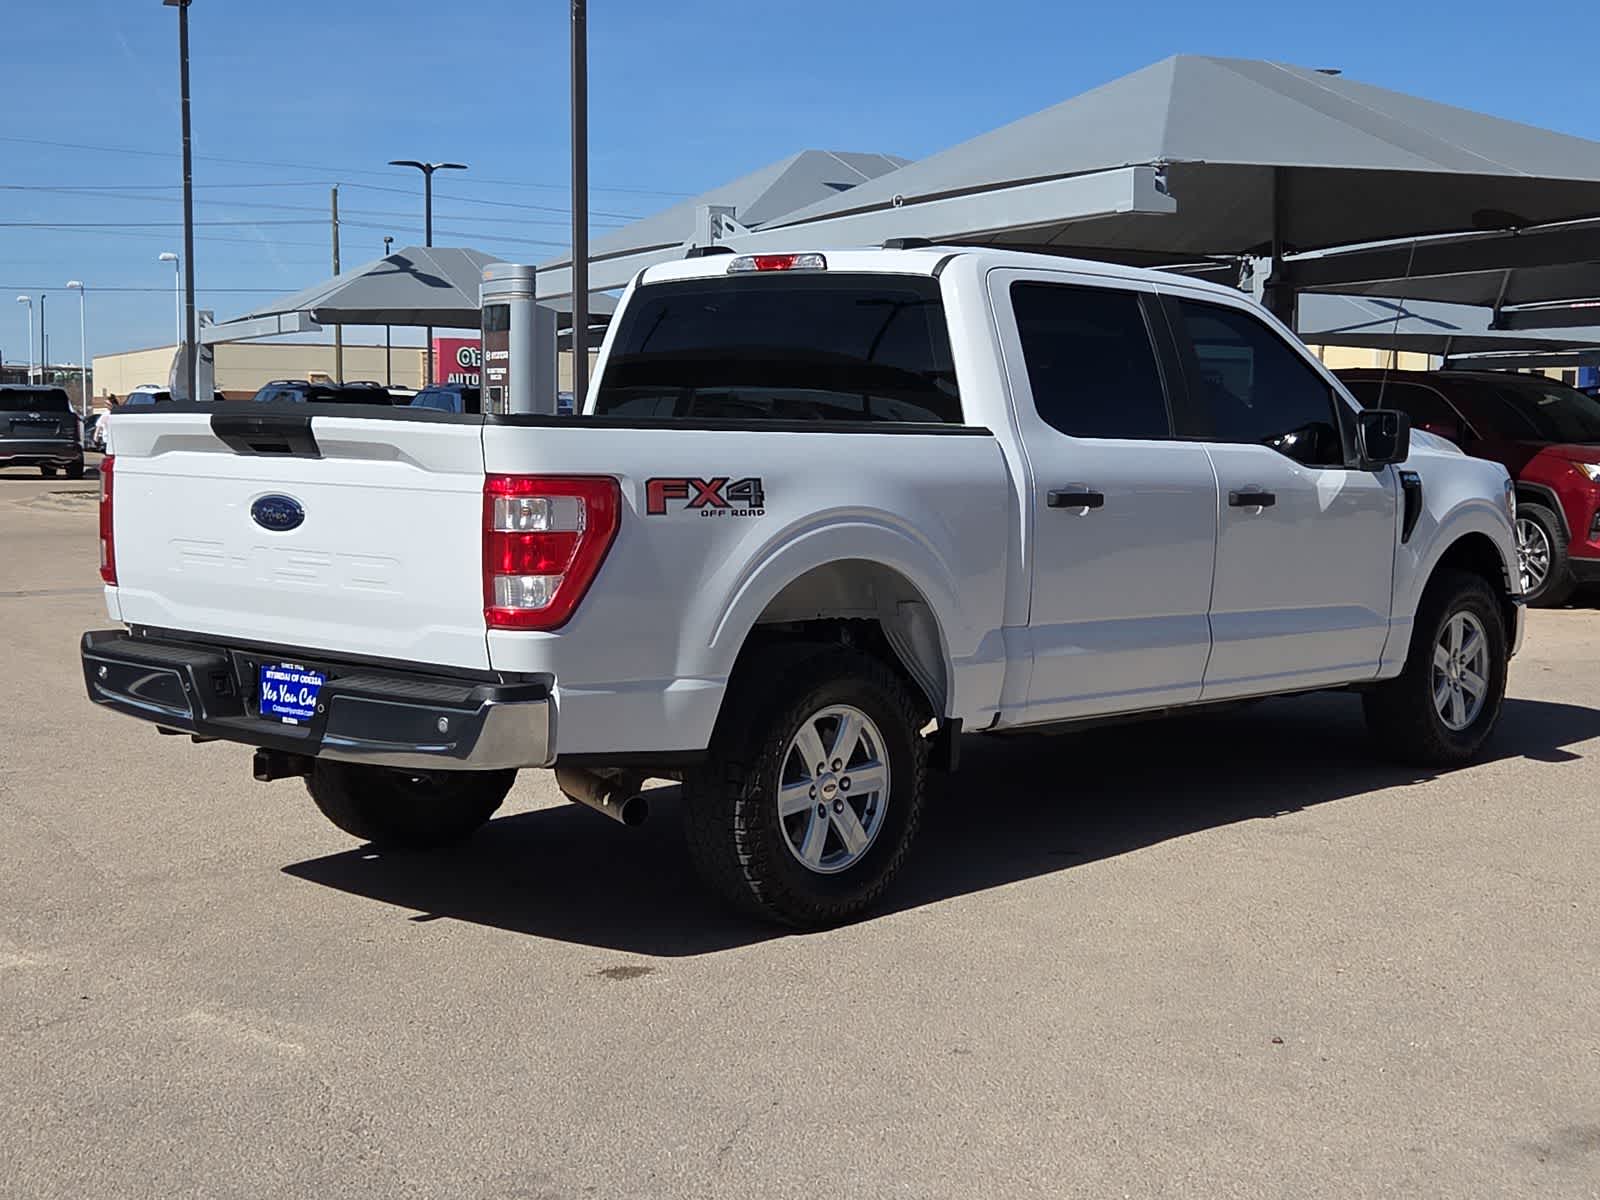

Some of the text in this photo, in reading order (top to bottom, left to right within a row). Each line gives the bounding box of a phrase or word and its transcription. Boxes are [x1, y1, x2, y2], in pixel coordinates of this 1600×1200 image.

[447, 372, 480, 385] AUTO
[645, 476, 765, 517] FX4
[700, 509, 766, 518] OFF ROAD
[291, 673, 300, 683] OF
[262, 681, 278, 702] Yes
[279, 684, 298, 704] You
